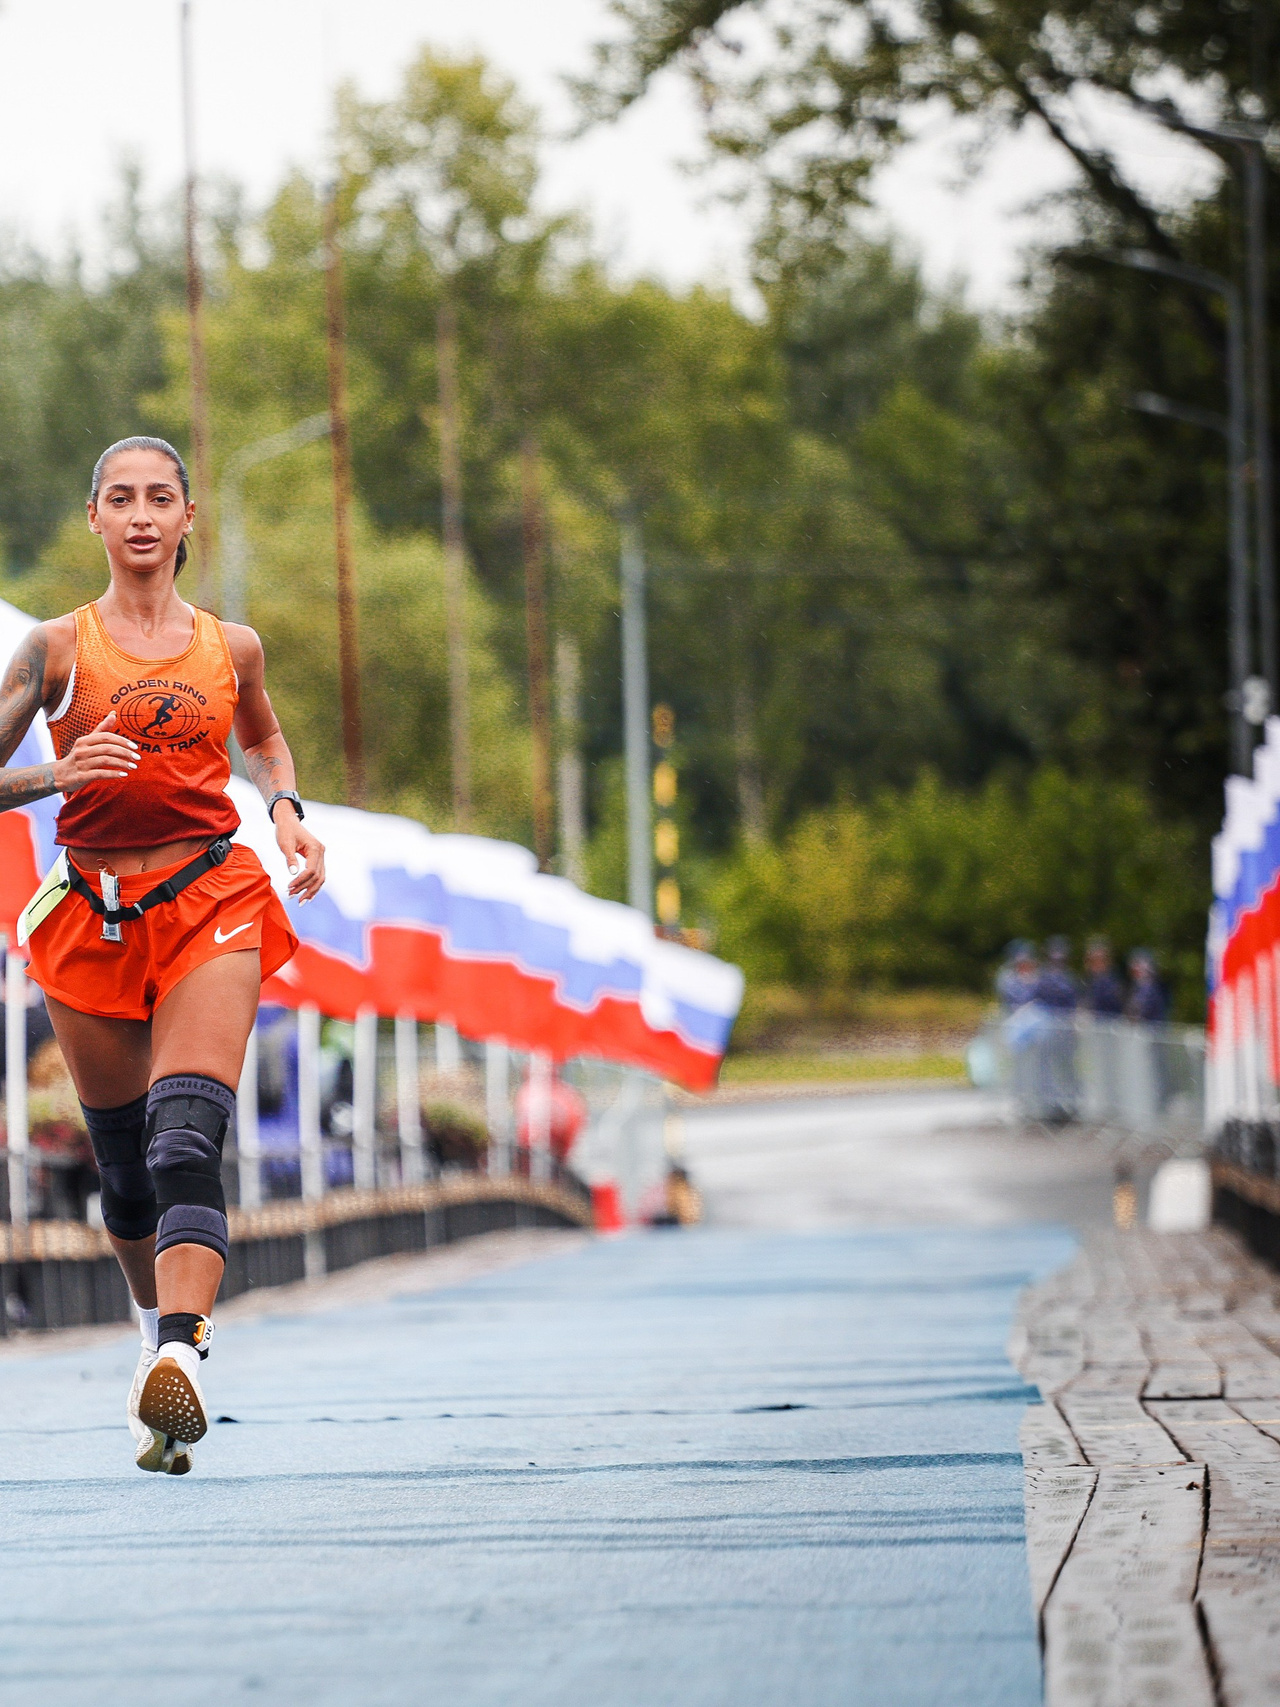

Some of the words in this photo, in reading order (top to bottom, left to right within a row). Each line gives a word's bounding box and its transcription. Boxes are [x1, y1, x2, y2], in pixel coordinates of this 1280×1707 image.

[110, 679, 169, 704] GOLDEN
[173, 680, 207, 706] RING
[166, 729, 210, 753] TRAIL
